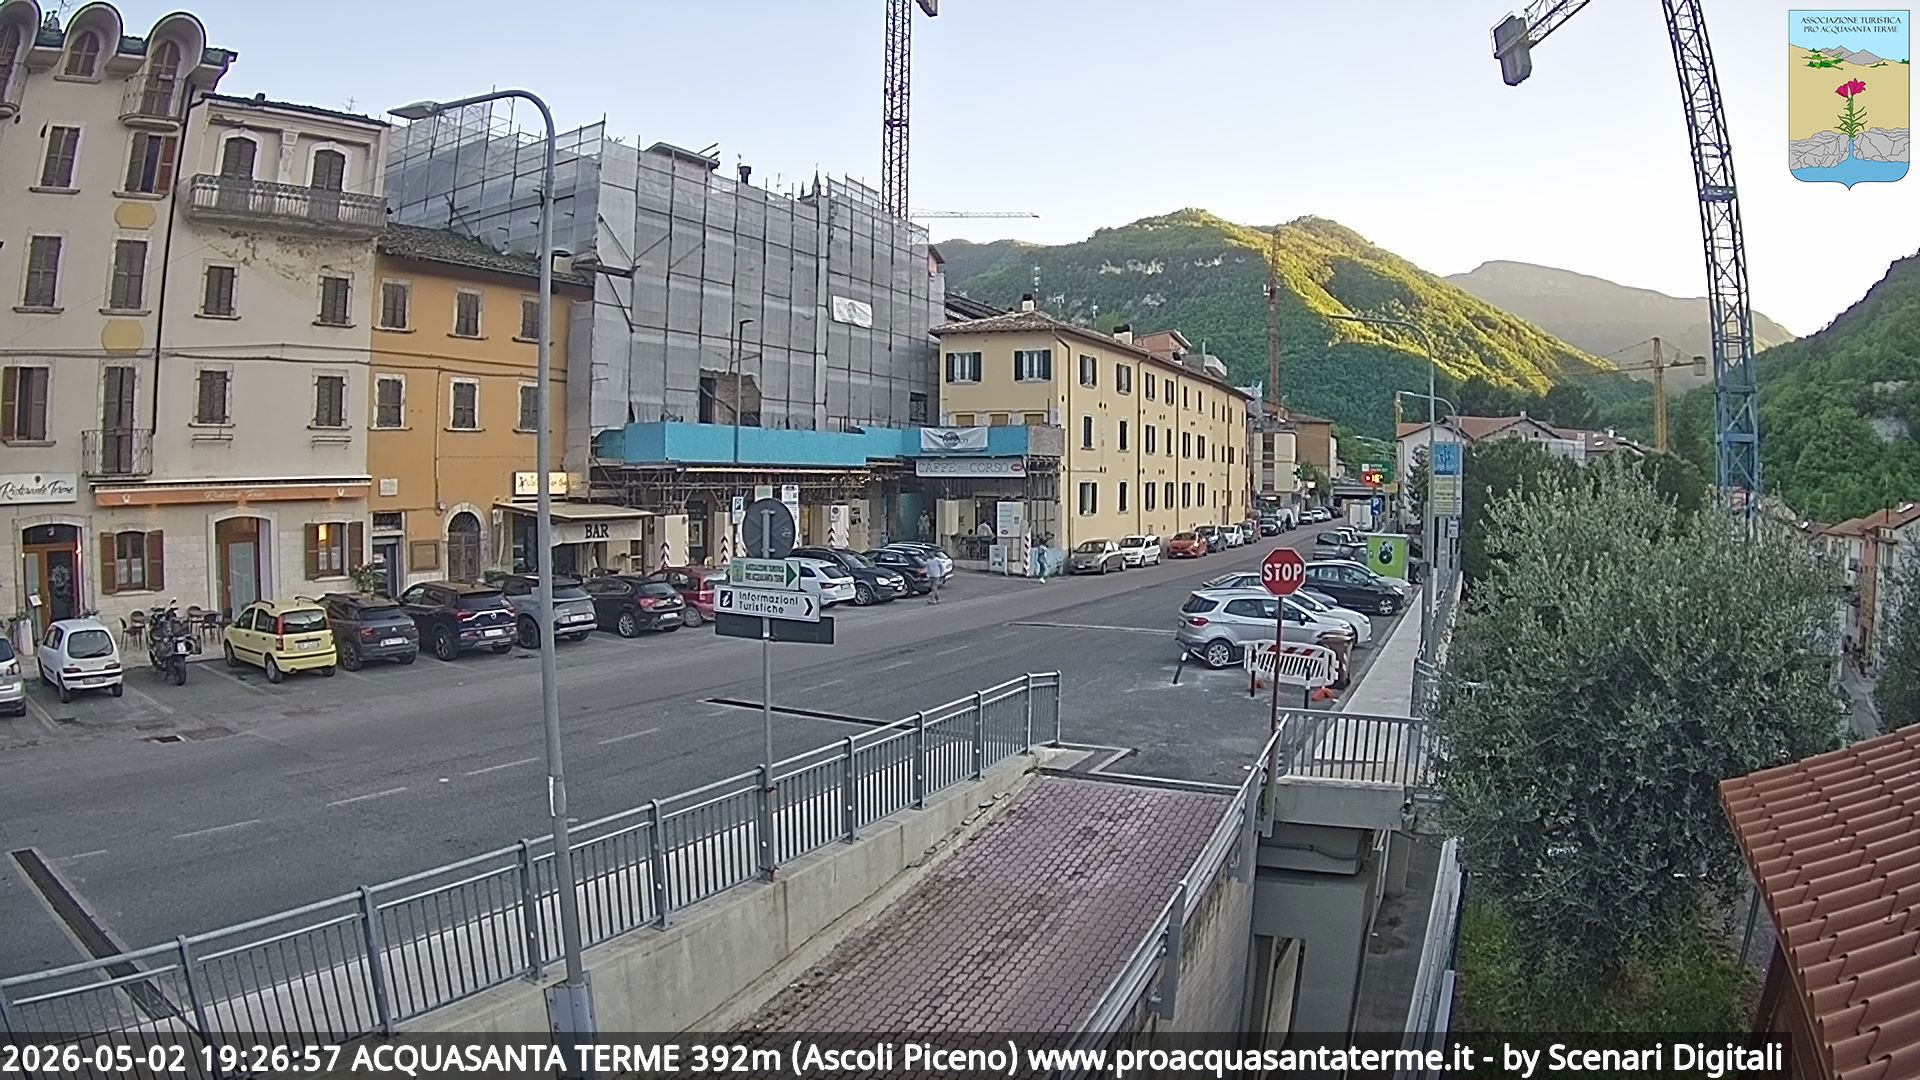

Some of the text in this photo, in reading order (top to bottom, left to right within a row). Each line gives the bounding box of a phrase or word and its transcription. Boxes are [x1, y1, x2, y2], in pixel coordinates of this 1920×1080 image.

[969, 462, 1009, 473] CORSO
[585, 523, 610, 539] BAR
[1263, 563, 1302, 582] STOP
[739, 591, 798, 605] Informazioni
[739, 601, 784, 614] Turistiche
